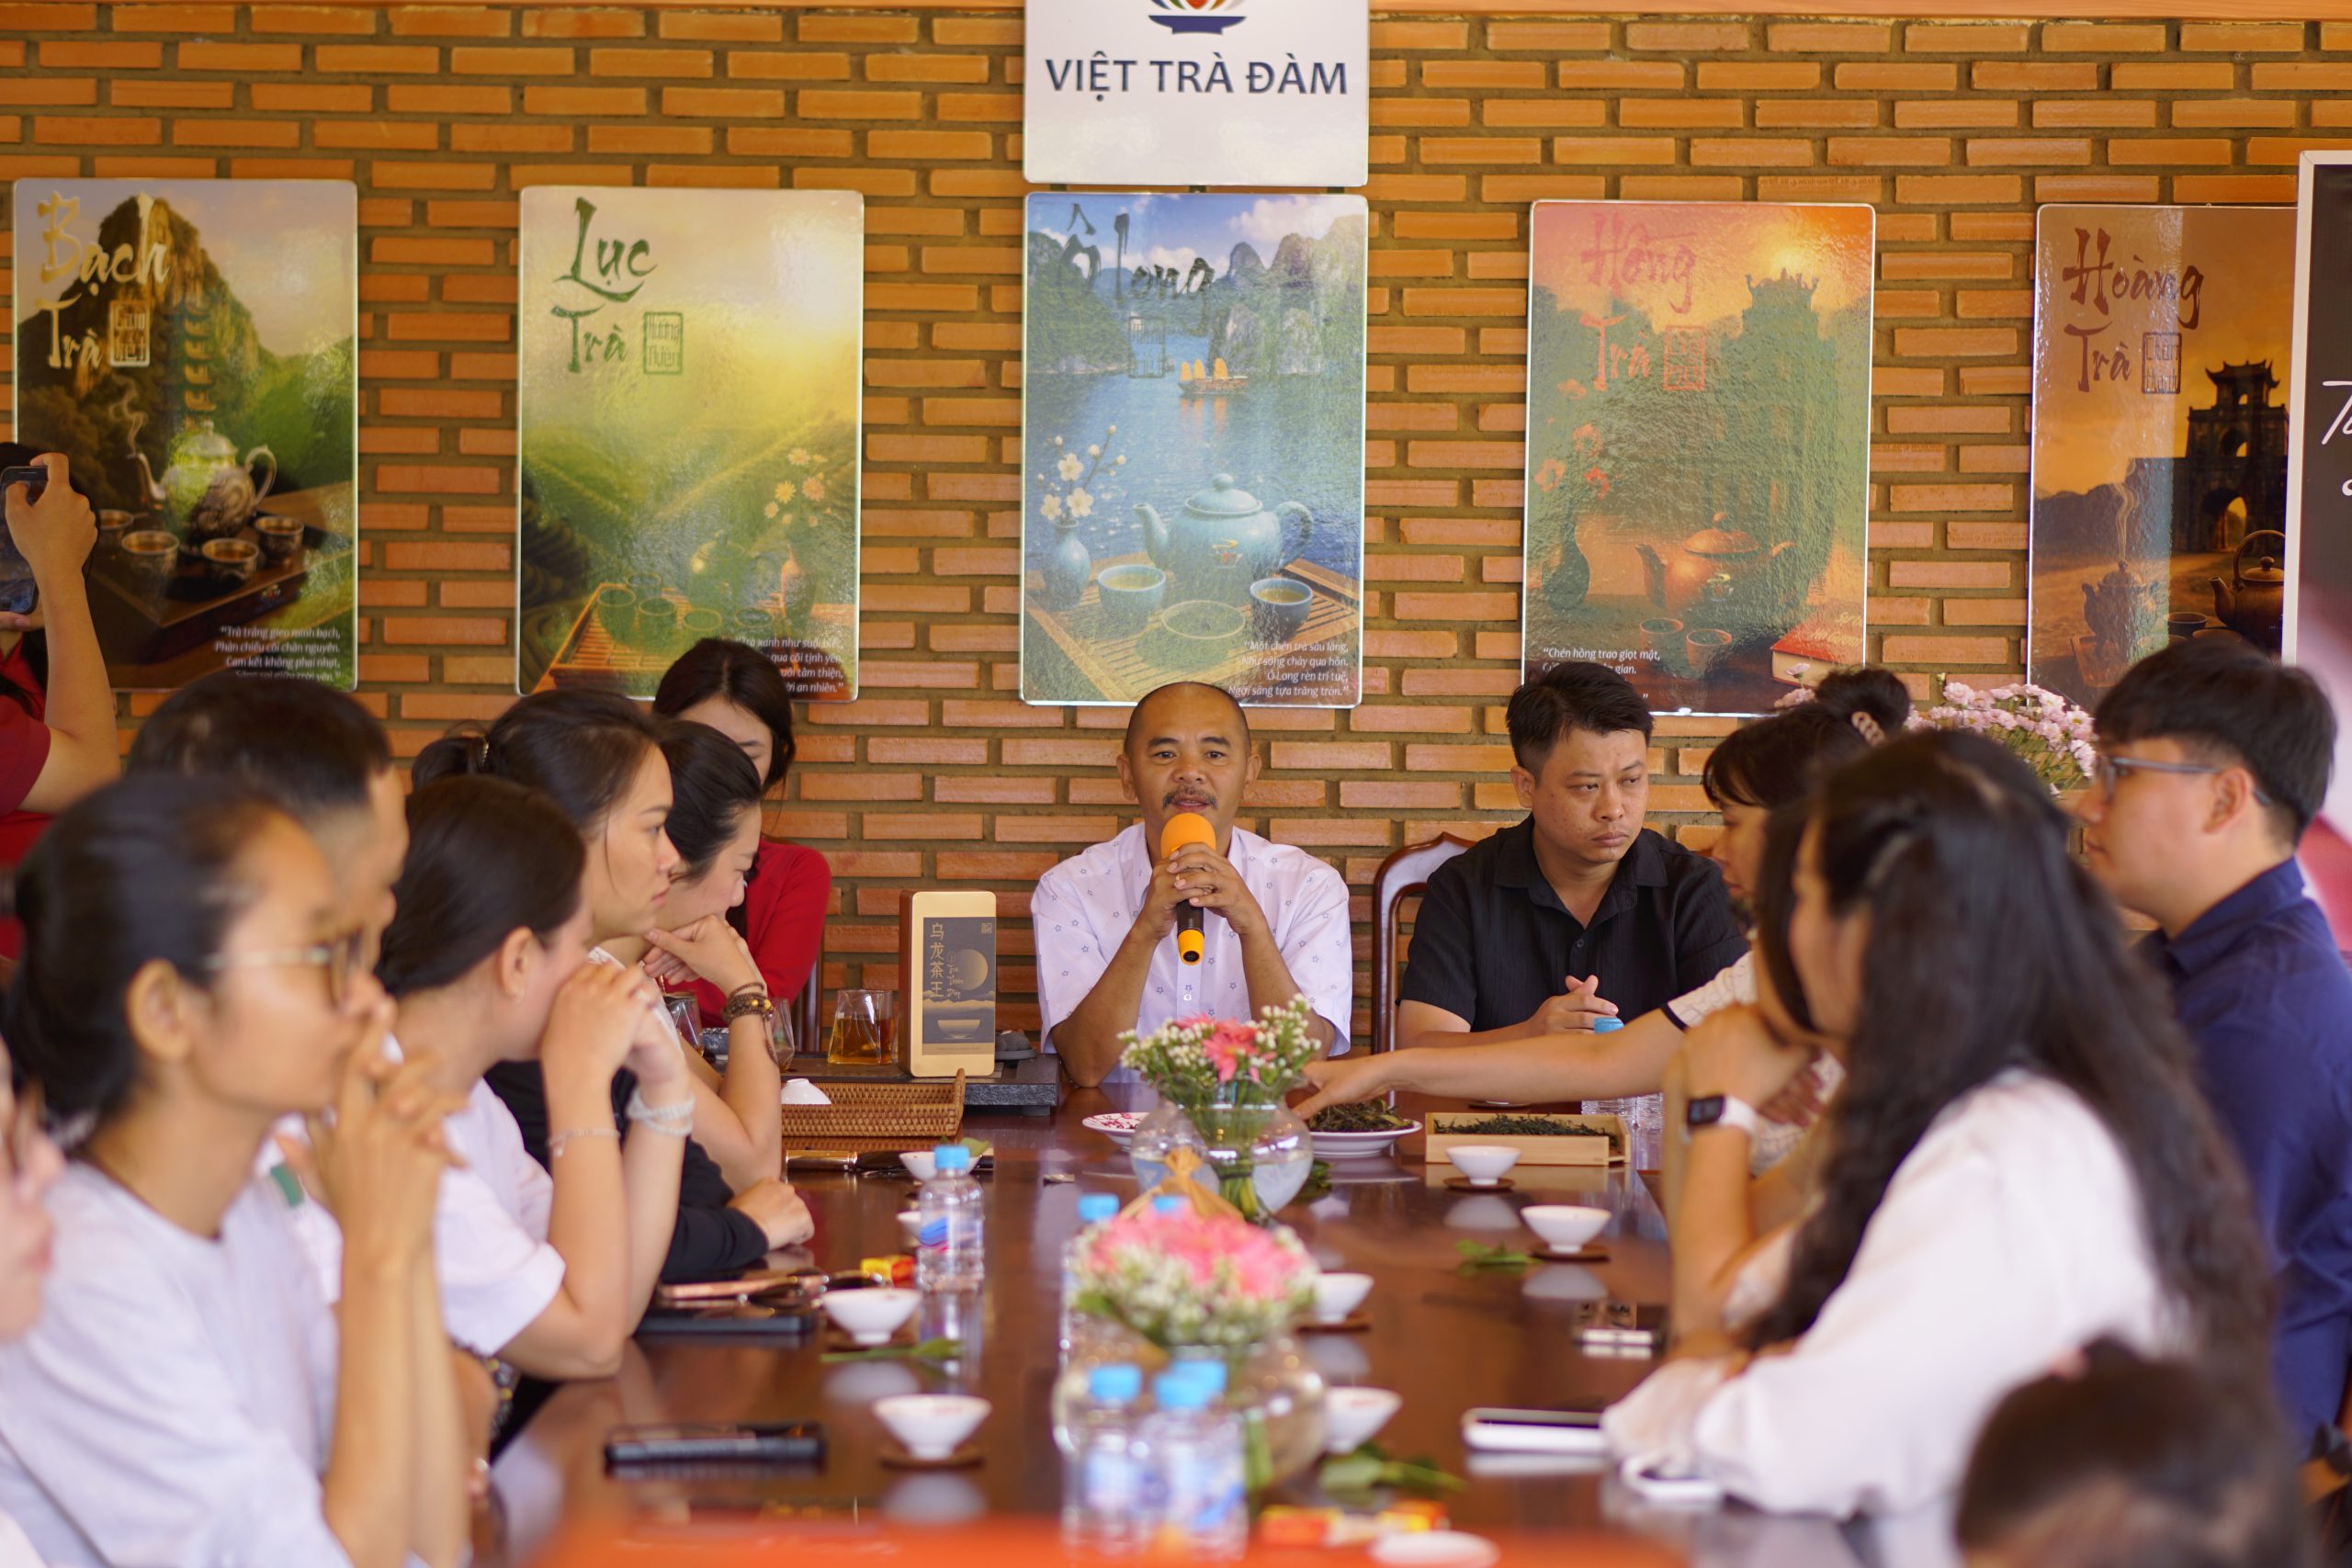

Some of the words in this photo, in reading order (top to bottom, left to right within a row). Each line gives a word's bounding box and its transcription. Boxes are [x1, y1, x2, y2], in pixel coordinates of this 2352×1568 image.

[1046, 51, 1137, 102] VIỆT
[1149, 52, 1234, 93] TRÀ
[1246, 52, 1348, 95] ĐÀM
[37, 189, 170, 296] Bạch
[552, 197, 658, 303] Lục
[1114, 212, 1216, 336] Long
[2063, 228, 2204, 330] Hoàng
[35, 293, 104, 368] Trà
[551, 303, 628, 373] Trà
[1579, 312, 1651, 391] Trà
[2064, 321, 2132, 392] Trà
[757, 637, 779, 648] xanh
[781, 637, 801, 648] như
[771, 653, 788, 664] qua
[797, 667, 816, 677] tâm
[1271, 641, 1293, 651] chén
[1277, 671, 1299, 683] Long
[1301, 671, 1316, 681] rèn
[1286, 656, 1308, 668] chảy
[1309, 658, 1327, 668] qua
[1573, 647, 1596, 660] hồng
[1599, 649, 1617, 659] trao
[1619, 649, 1637, 661] giọt
[1639, 649, 1660, 661] mật,
[930, 922, 944, 998] 乌龙茶王
